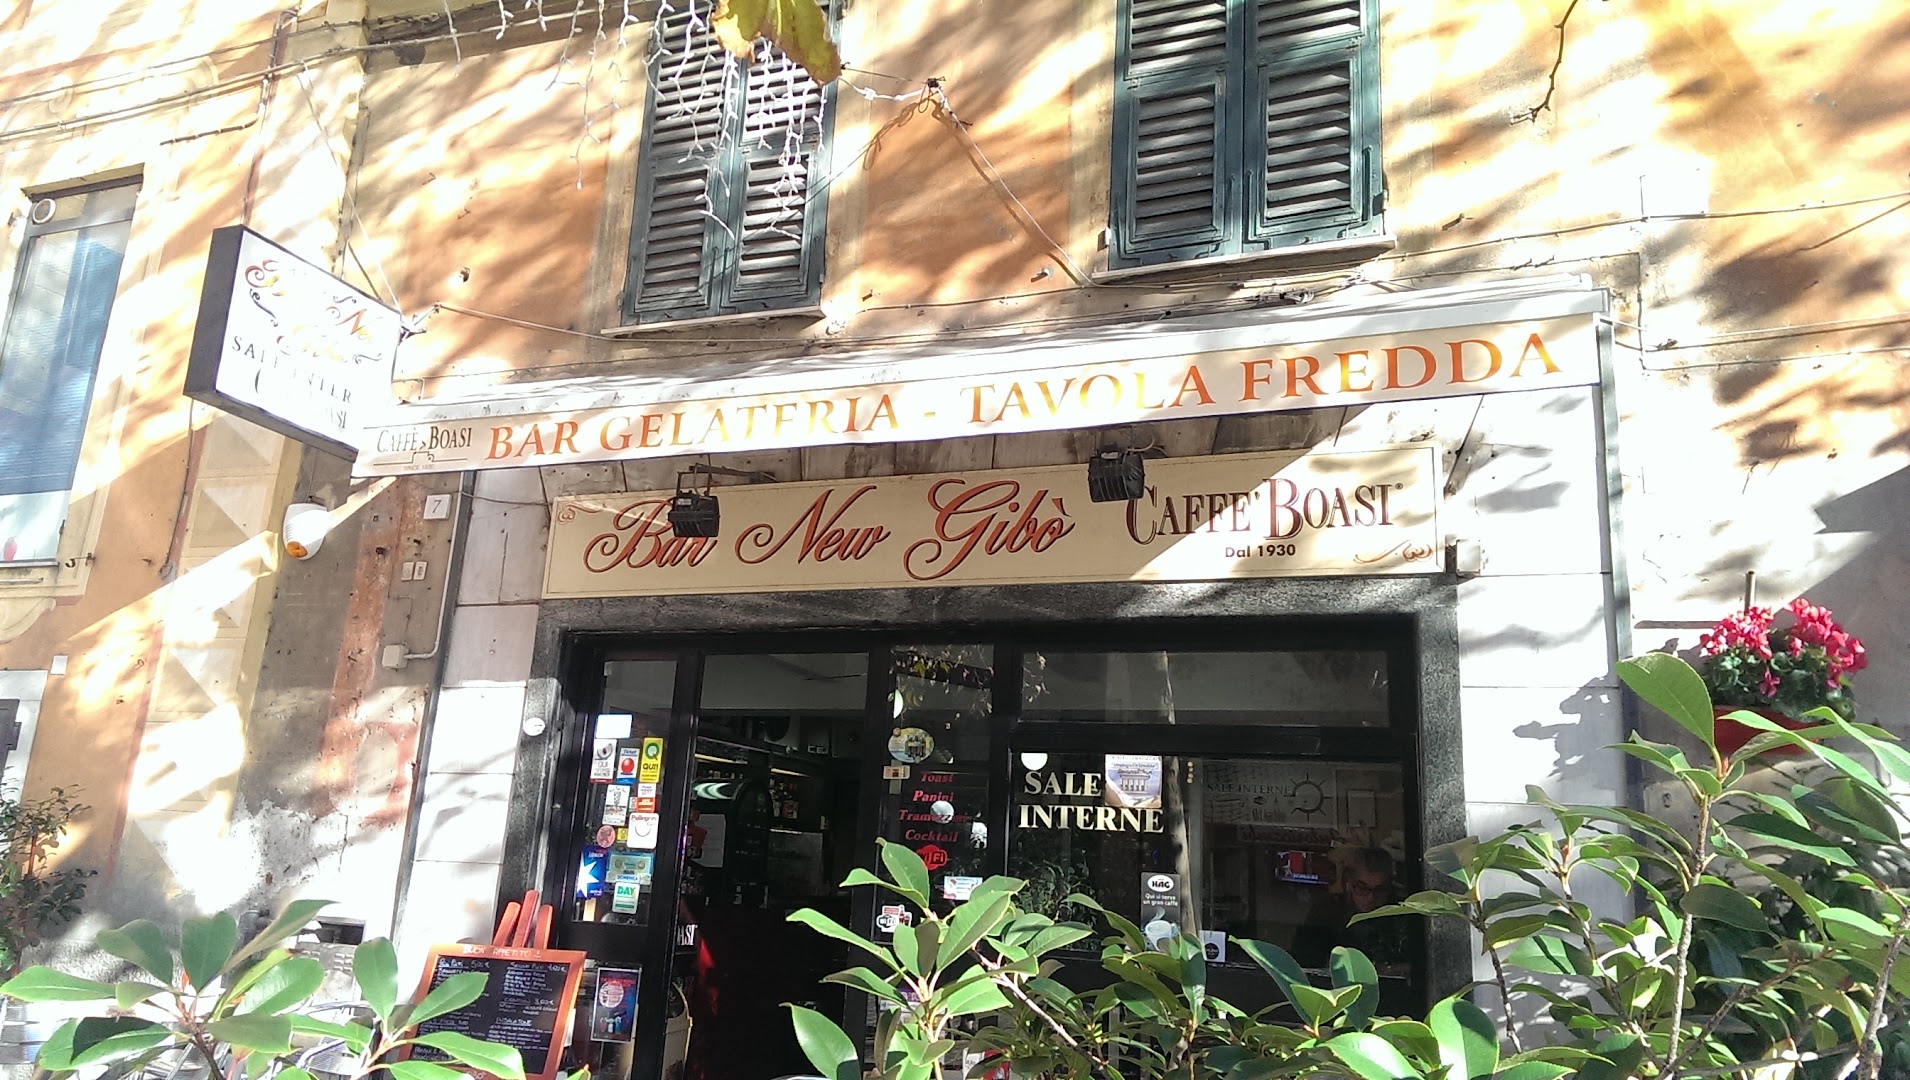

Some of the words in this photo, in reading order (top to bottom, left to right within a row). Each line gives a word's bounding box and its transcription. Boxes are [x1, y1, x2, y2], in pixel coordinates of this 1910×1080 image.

[485, 420, 580, 461] BAR
[599, 393, 899, 452] GELATERIA
[959, 364, 1217, 425] TAVOLA
[1239, 332, 1562, 402] FREDDA
[428, 426, 472, 450] BOASI
[432, 499, 442, 513] 7
[1263, 478, 1395, 540] BOASI
[583, 499, 720, 574] Bar
[734, 484, 891, 565] New
[902, 478, 1076, 580] Gibò
[1225, 545, 1251, 558] Dal
[1257, 544, 1297, 557] 1930
[1025, 771, 1101, 797] SALE
[1238, 784, 1292, 795] INTERNE
[912, 790, 954, 803] Panini
[1017, 804, 1164, 833] INTERNE
[905, 828, 959, 842] Cocktail
[617, 885, 636, 896] DAY
